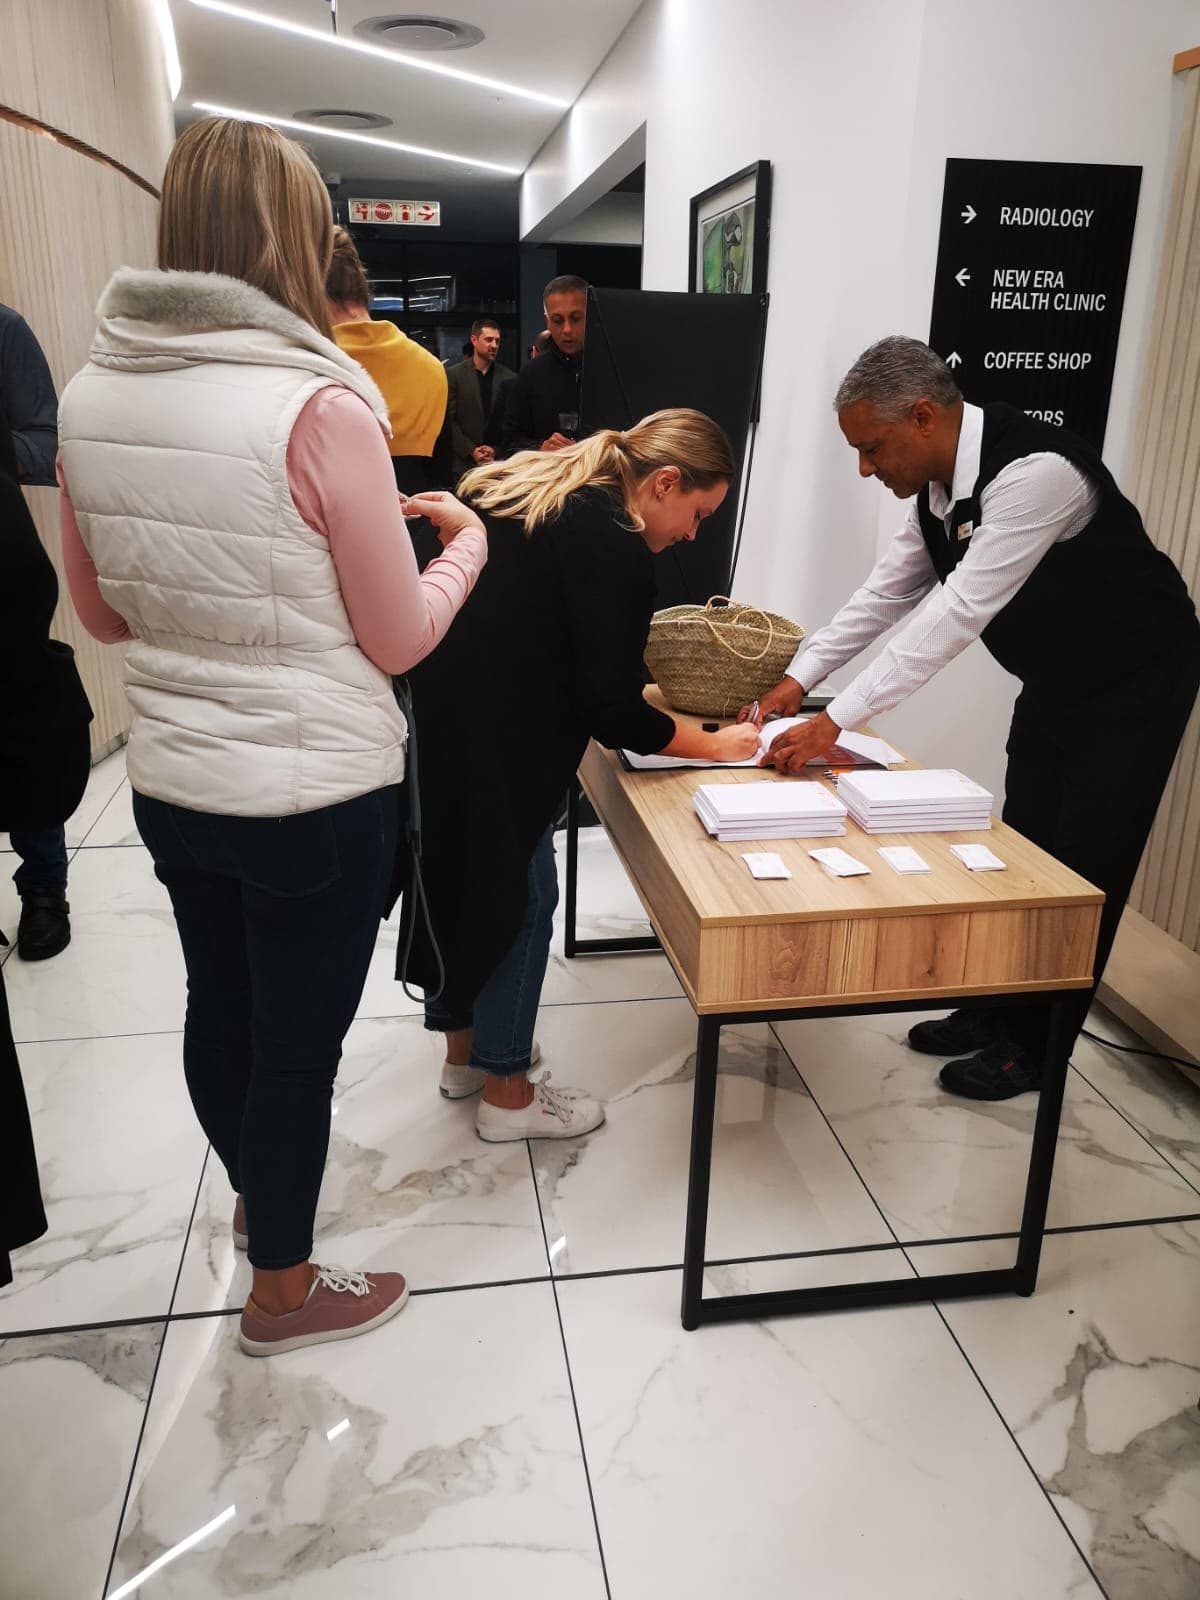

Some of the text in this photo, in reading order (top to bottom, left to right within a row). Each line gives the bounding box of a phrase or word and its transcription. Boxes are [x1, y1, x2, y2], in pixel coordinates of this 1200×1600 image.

[1000, 206, 1094, 227] RADIOLOGY
[993, 269, 1064, 288] NEW ERA
[990, 292, 1106, 312] HEALTH CLINIC
[984, 352, 1092, 370] COFFEE SHOP
